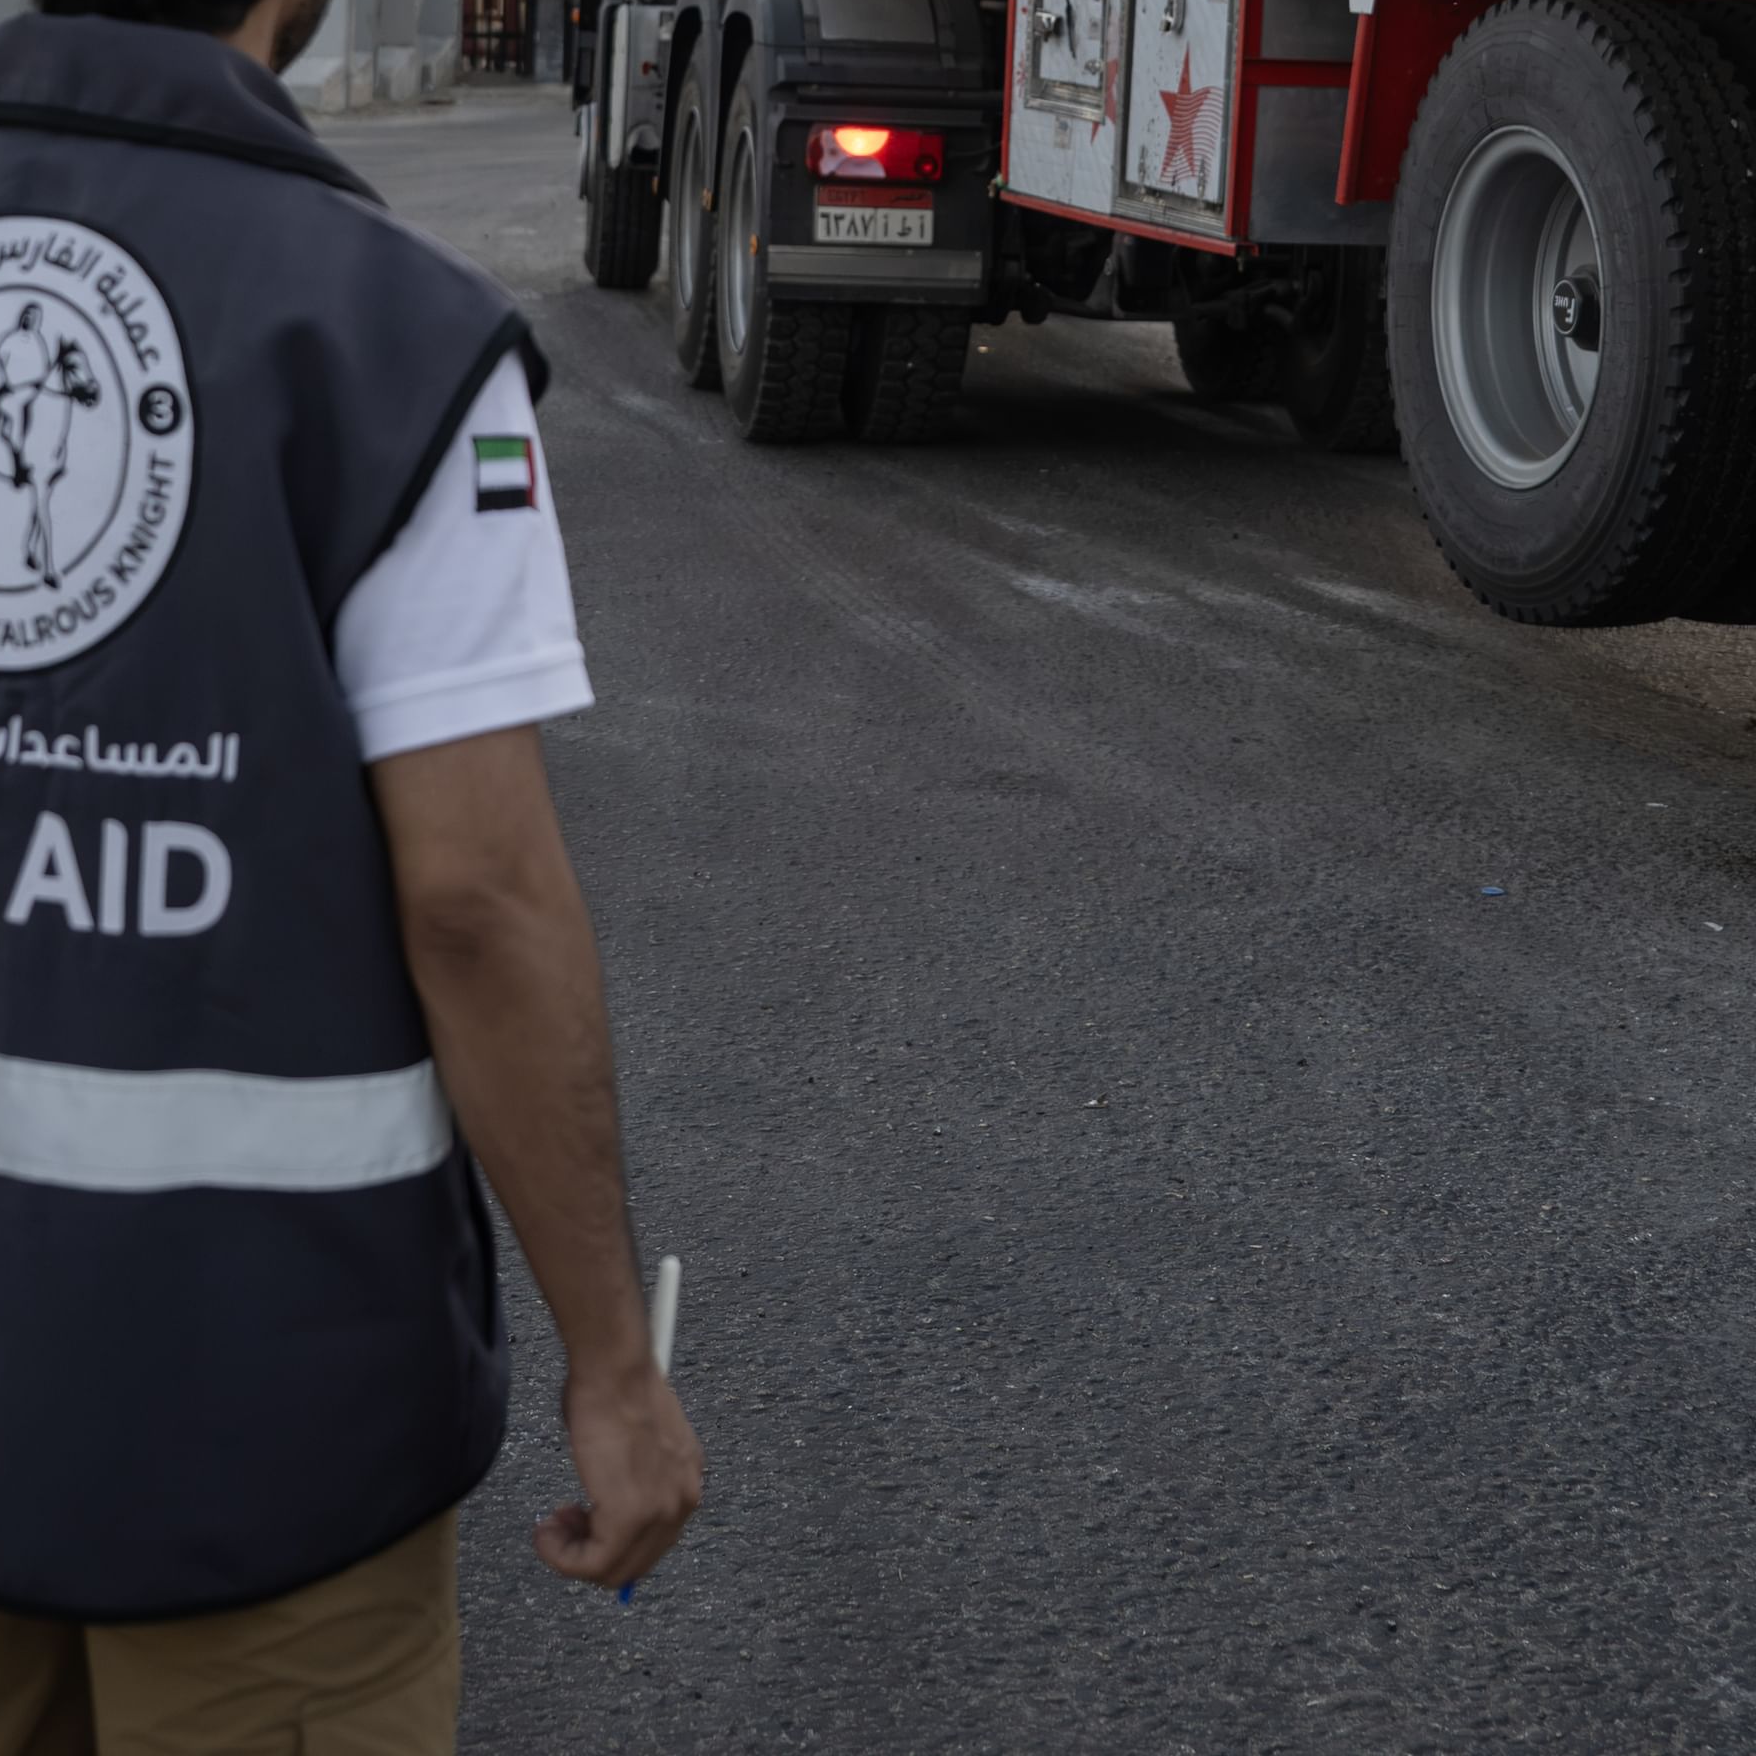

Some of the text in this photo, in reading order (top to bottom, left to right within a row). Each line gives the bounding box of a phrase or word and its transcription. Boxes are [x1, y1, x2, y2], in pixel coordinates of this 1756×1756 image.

[96, 265, 160, 371] عملية
[149, 390, 173, 423] 3
[112, 450, 175, 586] KNIGHT
[4, 811, 232, 937] AID
